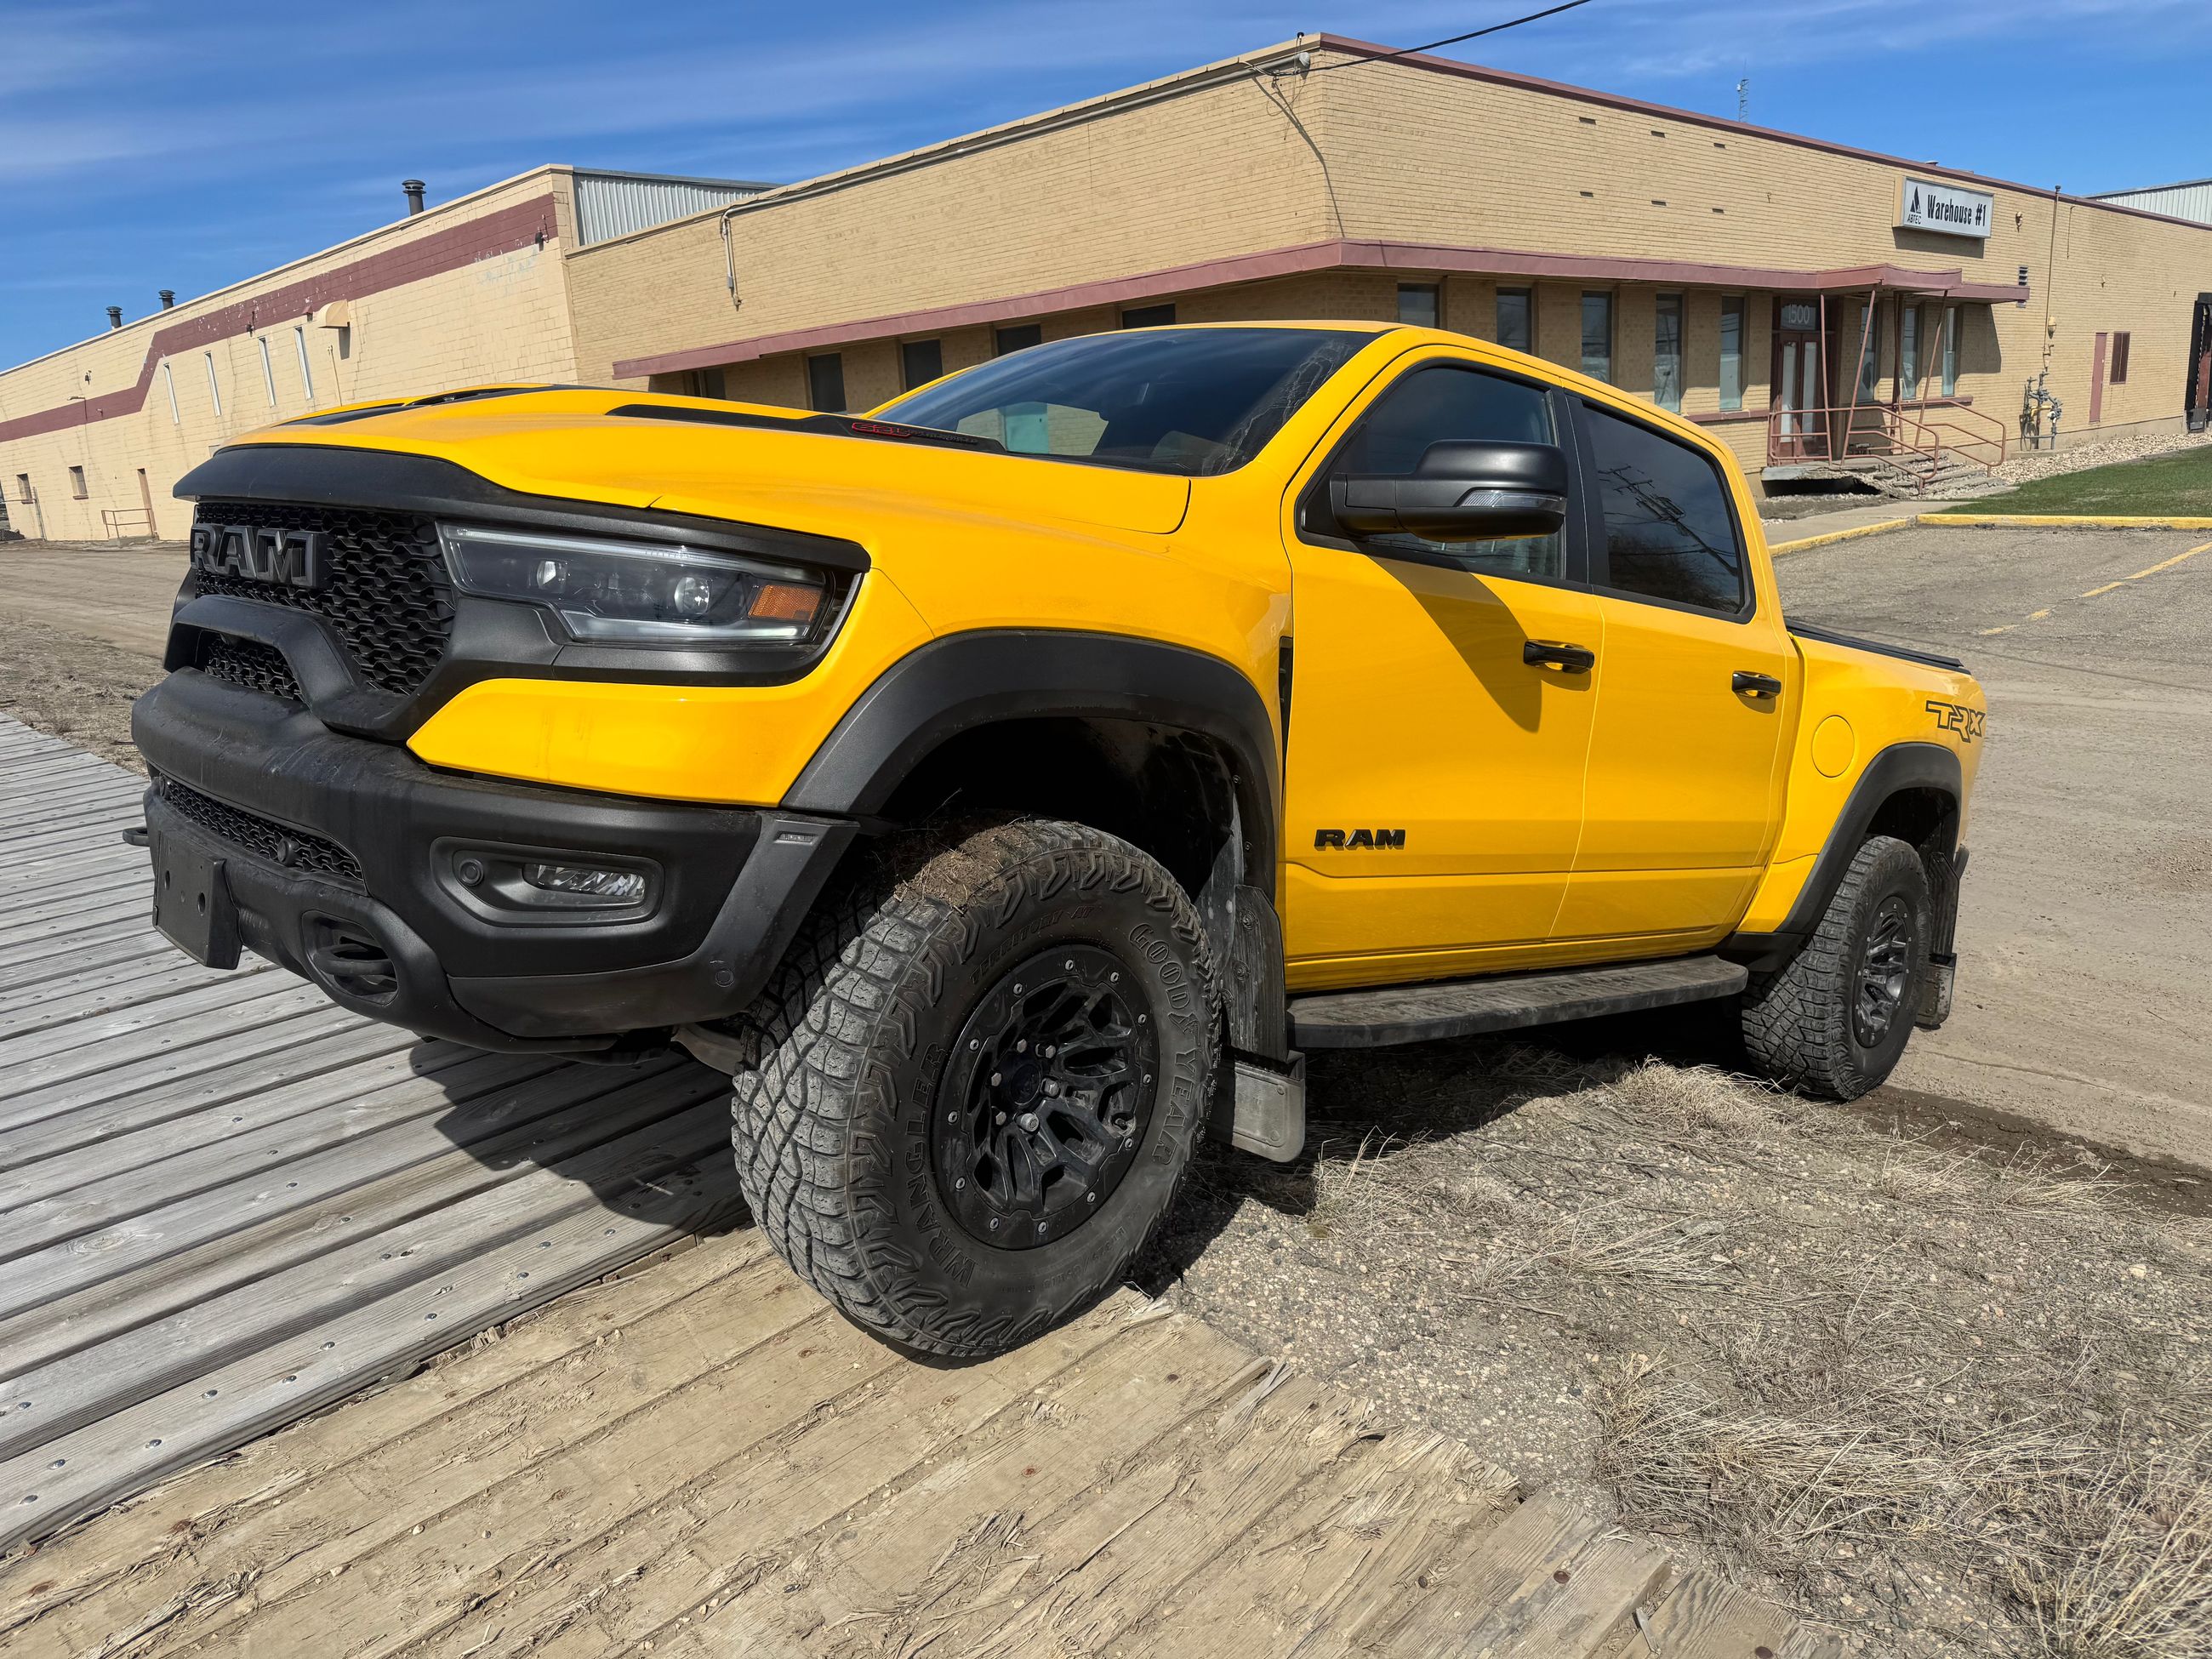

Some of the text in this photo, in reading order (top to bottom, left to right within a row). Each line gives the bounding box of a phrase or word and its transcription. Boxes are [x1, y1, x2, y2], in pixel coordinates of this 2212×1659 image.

[1907, 214, 1921, 224] ABTEC
[1927, 194, 1987, 227] Warehouse #1
[1788, 304, 1810, 323] 1500
[190, 523, 316, 587] RAM
[1925, 700, 1986, 743] TRX
[1314, 829, 1405, 849] RAM
[970, 909, 1063, 984] TERRITORY
[905, 1042, 978, 1287] WRANGLER
